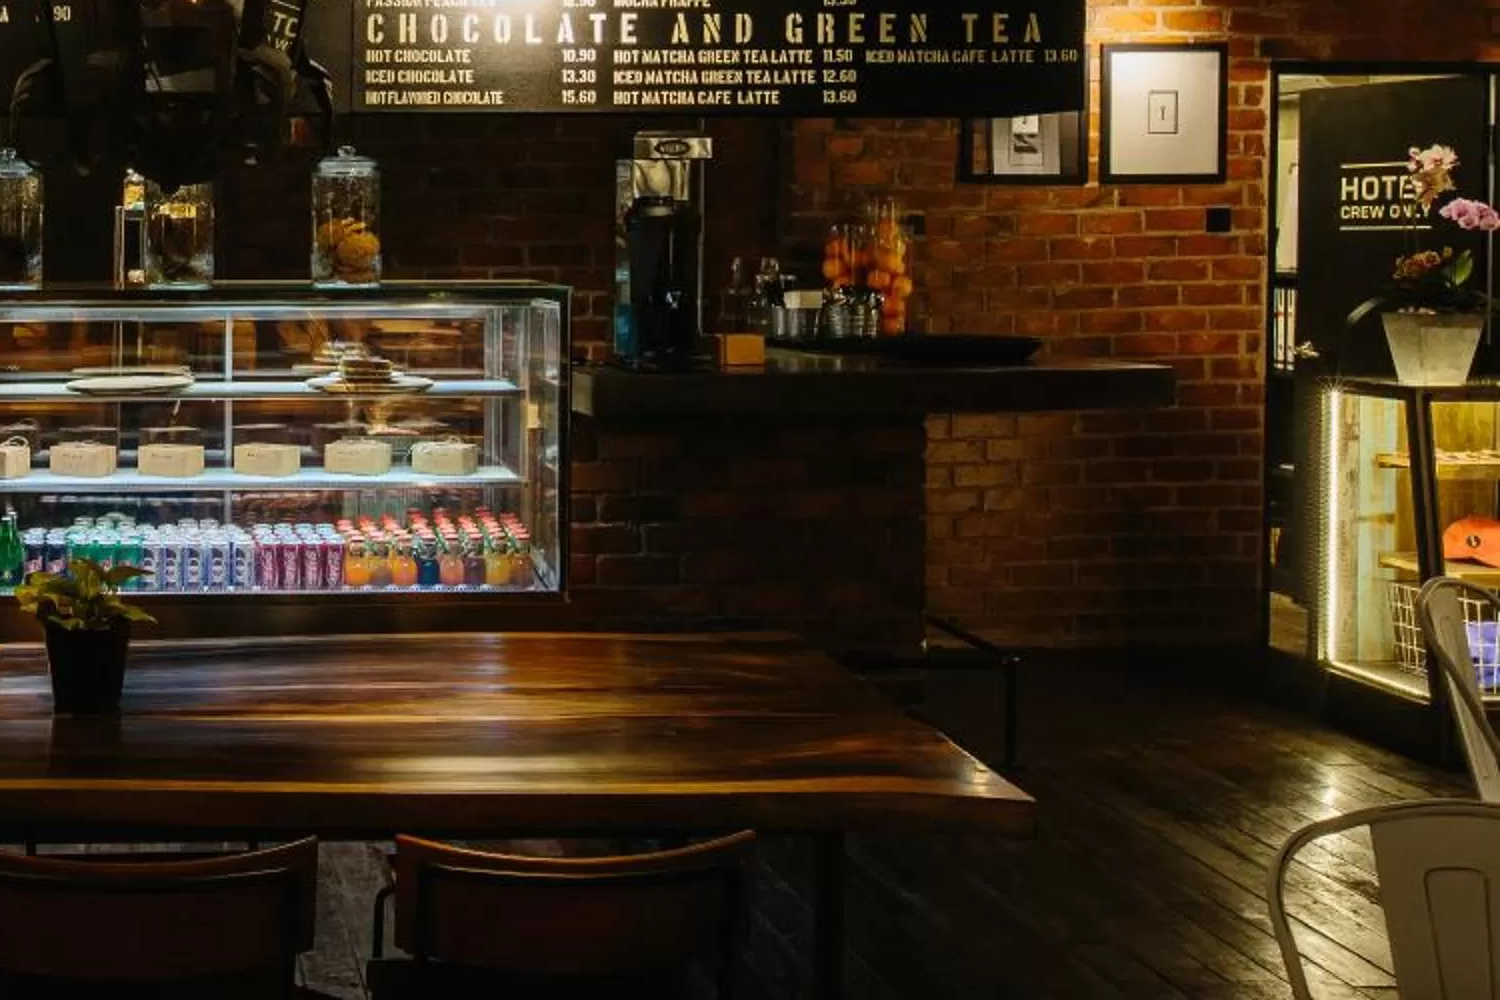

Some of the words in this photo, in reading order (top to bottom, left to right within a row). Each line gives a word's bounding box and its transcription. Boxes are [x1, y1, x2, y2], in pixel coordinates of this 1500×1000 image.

[367, 12, 638, 44] CHOCOLATE
[672, 12, 753, 44] AND
[786, 12, 927, 44] GREEN
[962, 12, 1041, 44] TEA
[366, 49, 393, 63] HOT
[394, 49, 471, 63] CHOCOLATE
[562, 49, 596, 63] 10.90
[614, 49, 640, 63] HOT
[642, 49, 694, 63] MATCHA
[697, 49, 741, 63] GREEN
[744, 49, 769, 63] TEA
[771, 49, 812, 63] LATTE
[823, 49, 853, 63] 11.50
[866, 49, 894, 63] ICED
[897, 49, 949, 63] MATCHA
[953, 49, 985, 63] CAFE
[992, 49, 1034, 63] LATTE
[366, 70, 395, 84] ICED
[397, 70, 474, 84] CHOCOLATE
[562, 70, 596, 84] 13.30
[614, 70, 642, 84] ICED
[644, 70, 698, 84] MATCHA
[701, 70, 743, 84] GREEN
[746, 70, 771, 84] TEA
[774, 70, 816, 84] LATTE
[823, 70, 857, 84] 12.60
[366, 91, 387, 105] HOT
[387, 91, 441, 105] FLAVORED
[443, 91, 504, 105] CHOCOLATE
[562, 91, 596, 105] 15.60
[614, 91, 640, 105] HOT
[642, 91, 694, 105] MATCHA
[697, 91, 729, 105] CAFE
[738, 91, 780, 105] LATTE
[823, 91, 857, 105] 13.60
[1341, 175, 1415, 201] HOTE
[1341, 206, 1385, 219] CREW
[1390, 204, 1431, 219] ONY
